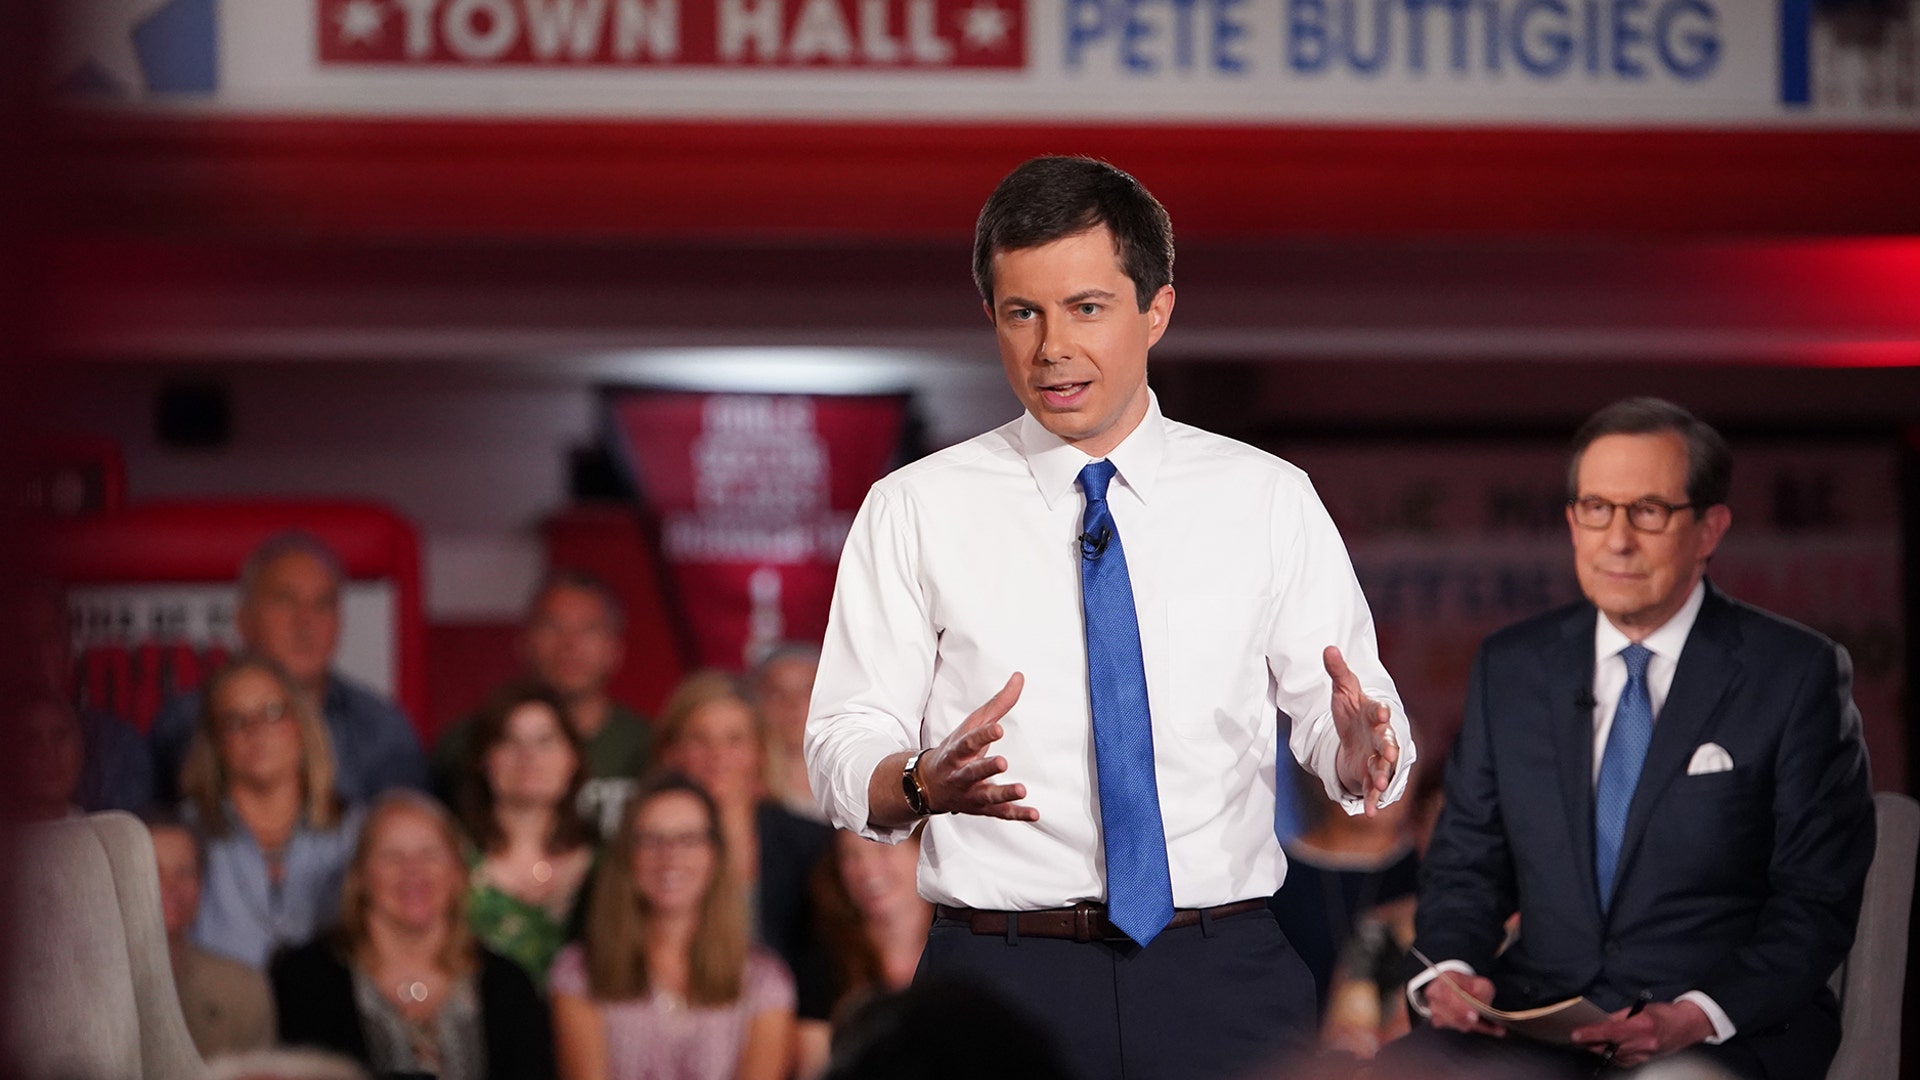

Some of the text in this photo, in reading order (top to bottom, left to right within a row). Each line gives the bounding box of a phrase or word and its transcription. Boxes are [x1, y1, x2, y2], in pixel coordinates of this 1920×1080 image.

[388, 0, 955, 63] TOWN HALL
[1062, 0, 1725, 80] PETE BUTTIGIEG
